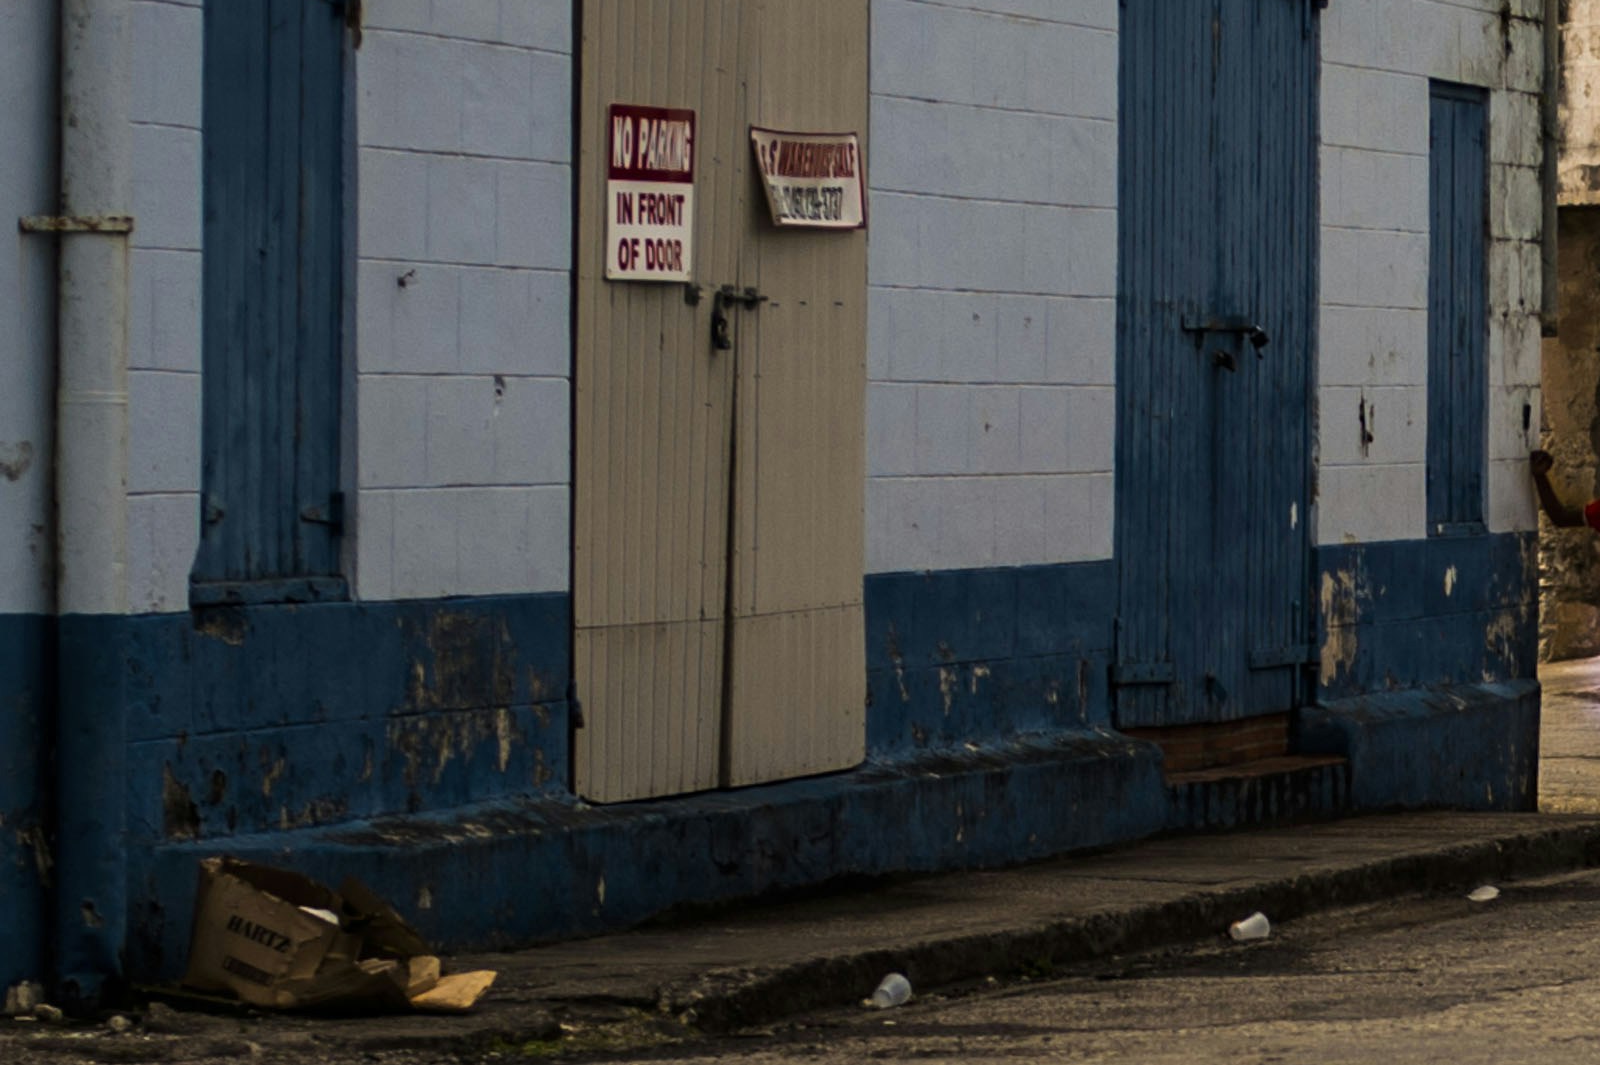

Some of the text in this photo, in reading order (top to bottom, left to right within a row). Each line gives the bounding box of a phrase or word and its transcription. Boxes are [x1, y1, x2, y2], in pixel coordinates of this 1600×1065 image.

[612, 115, 634, 170] NO
[637, 117, 692, 173] PARKING
[616, 191, 685, 227] IN FRONT
[618, 237, 683, 273] OF DOOR
[226, 914, 292, 954] HARTZ
